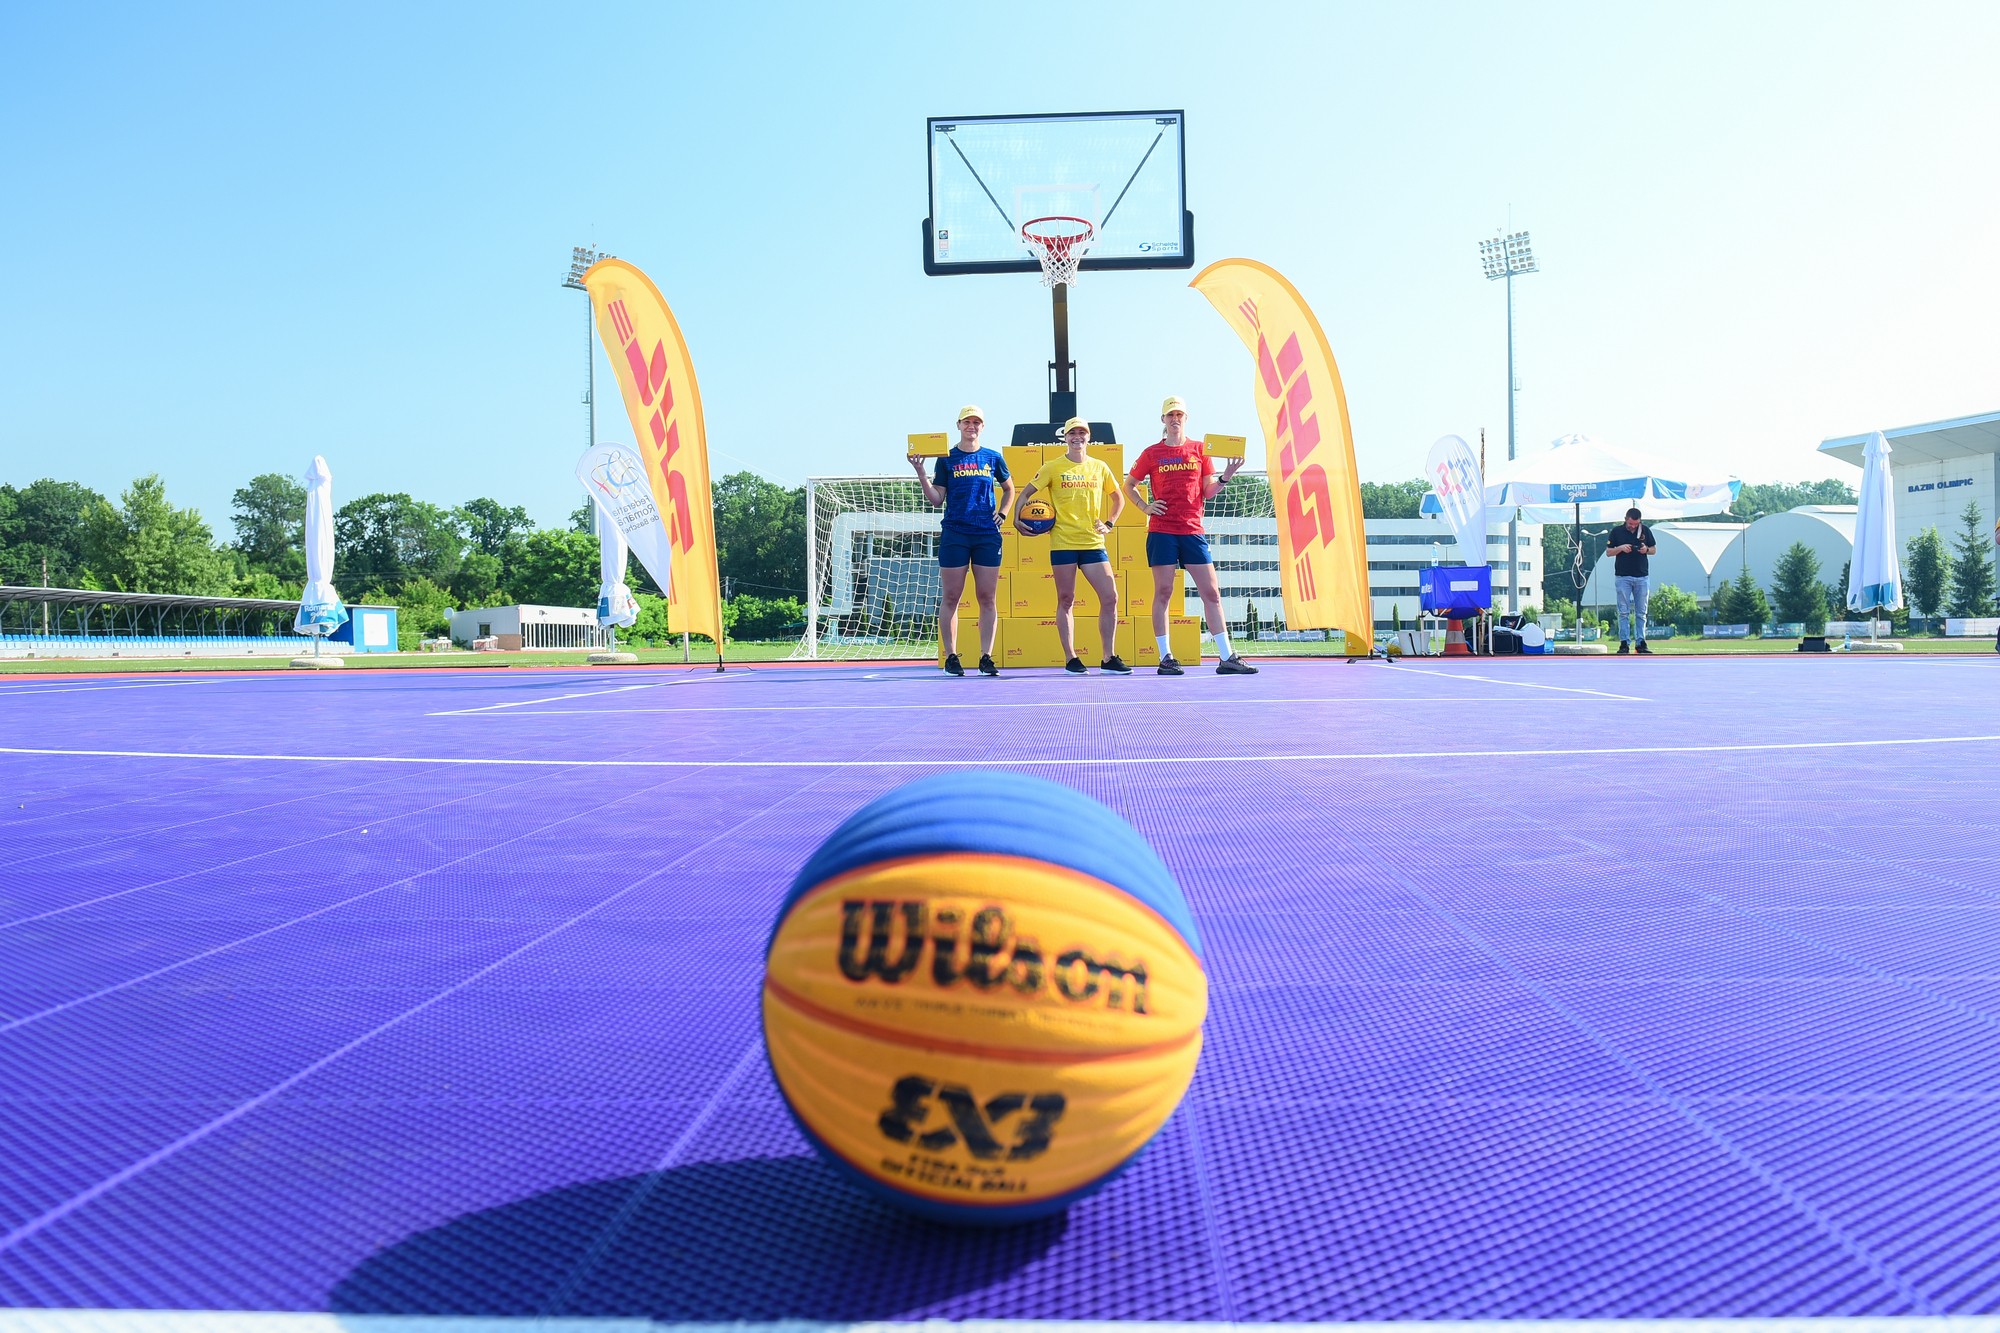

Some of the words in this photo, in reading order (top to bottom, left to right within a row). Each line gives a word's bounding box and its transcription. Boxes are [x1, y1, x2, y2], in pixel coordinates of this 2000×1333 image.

[1158, 457, 1183, 465] TEAM
[953, 463, 978, 471] TEAM
[1158, 463, 1199, 473] ROMANIA
[953, 469, 991, 478] ROMANIA
[1061, 481, 1098, 489] ROMANIA
[1561, 483, 1597, 492] Romania
[1908, 483, 1935, 493] BAZIN
[1937, 478, 1974, 490] OLIMPIC
[1567, 490, 1588, 503] gold
[838, 900, 1148, 1015] Wilson
